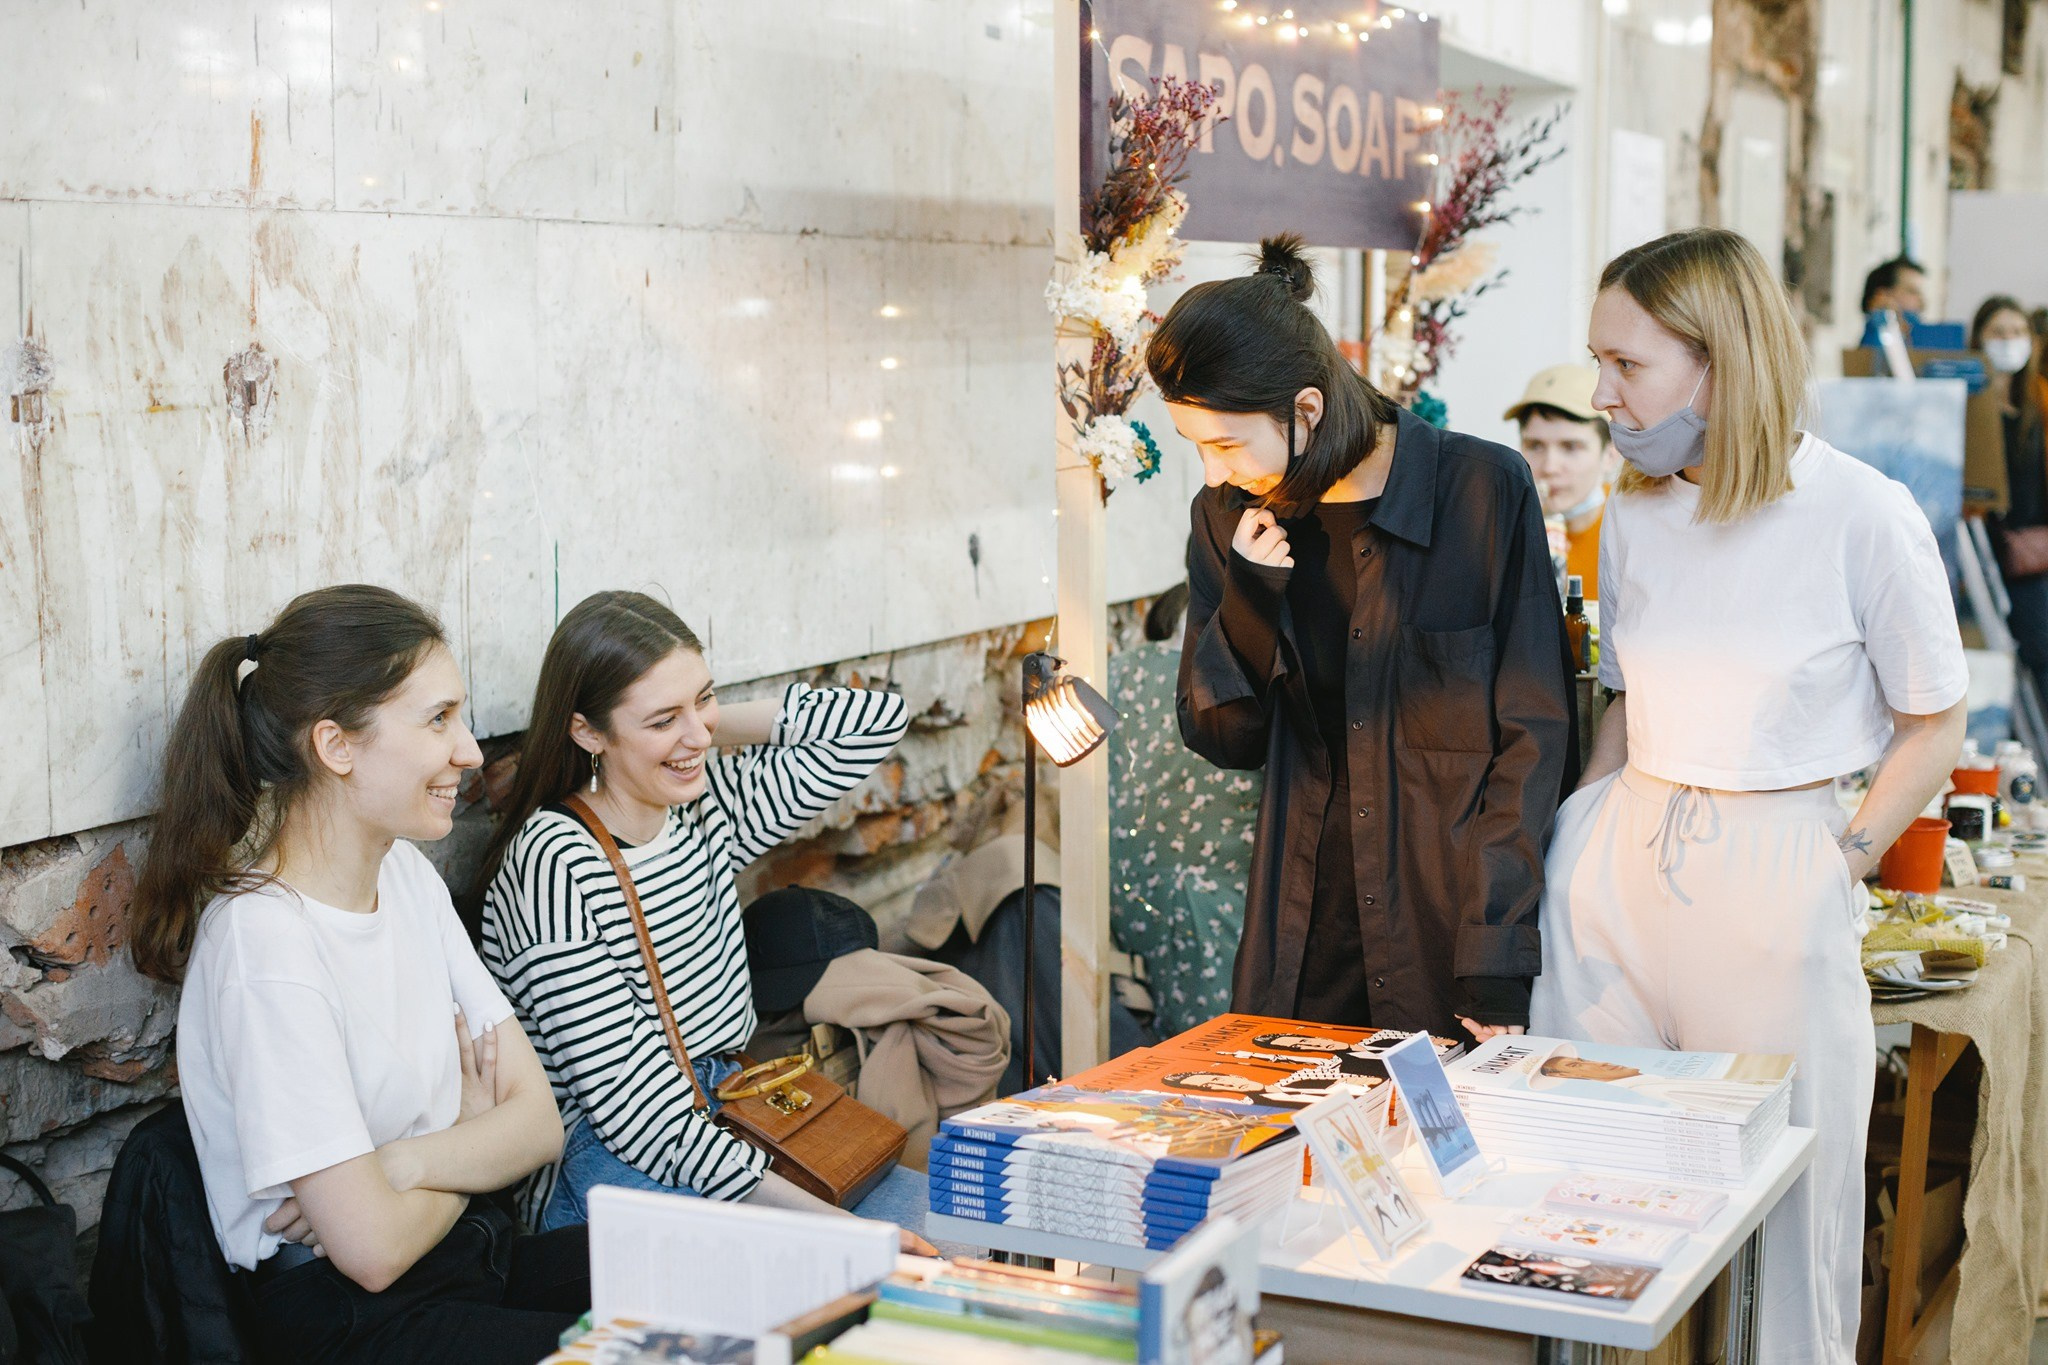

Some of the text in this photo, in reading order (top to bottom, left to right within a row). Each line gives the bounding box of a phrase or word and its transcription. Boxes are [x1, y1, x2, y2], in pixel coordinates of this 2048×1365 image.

[1181, 1019, 1263, 1051] ORNAMENT
[1472, 1045, 1533, 1074] ORNAMENT
[963, 1128, 996, 1141] ORNAMENT
[954, 1144, 986, 1156] ORNAMENT
[952, 1157, 984, 1170] ORNAMENT
[951, 1169, 983, 1183] ORNAMENT
[952, 1183, 984, 1195] ORNAMENT
[952, 1195, 985, 1208] ORNAMENT
[953, 1206, 986, 1220] ORNAMENT
